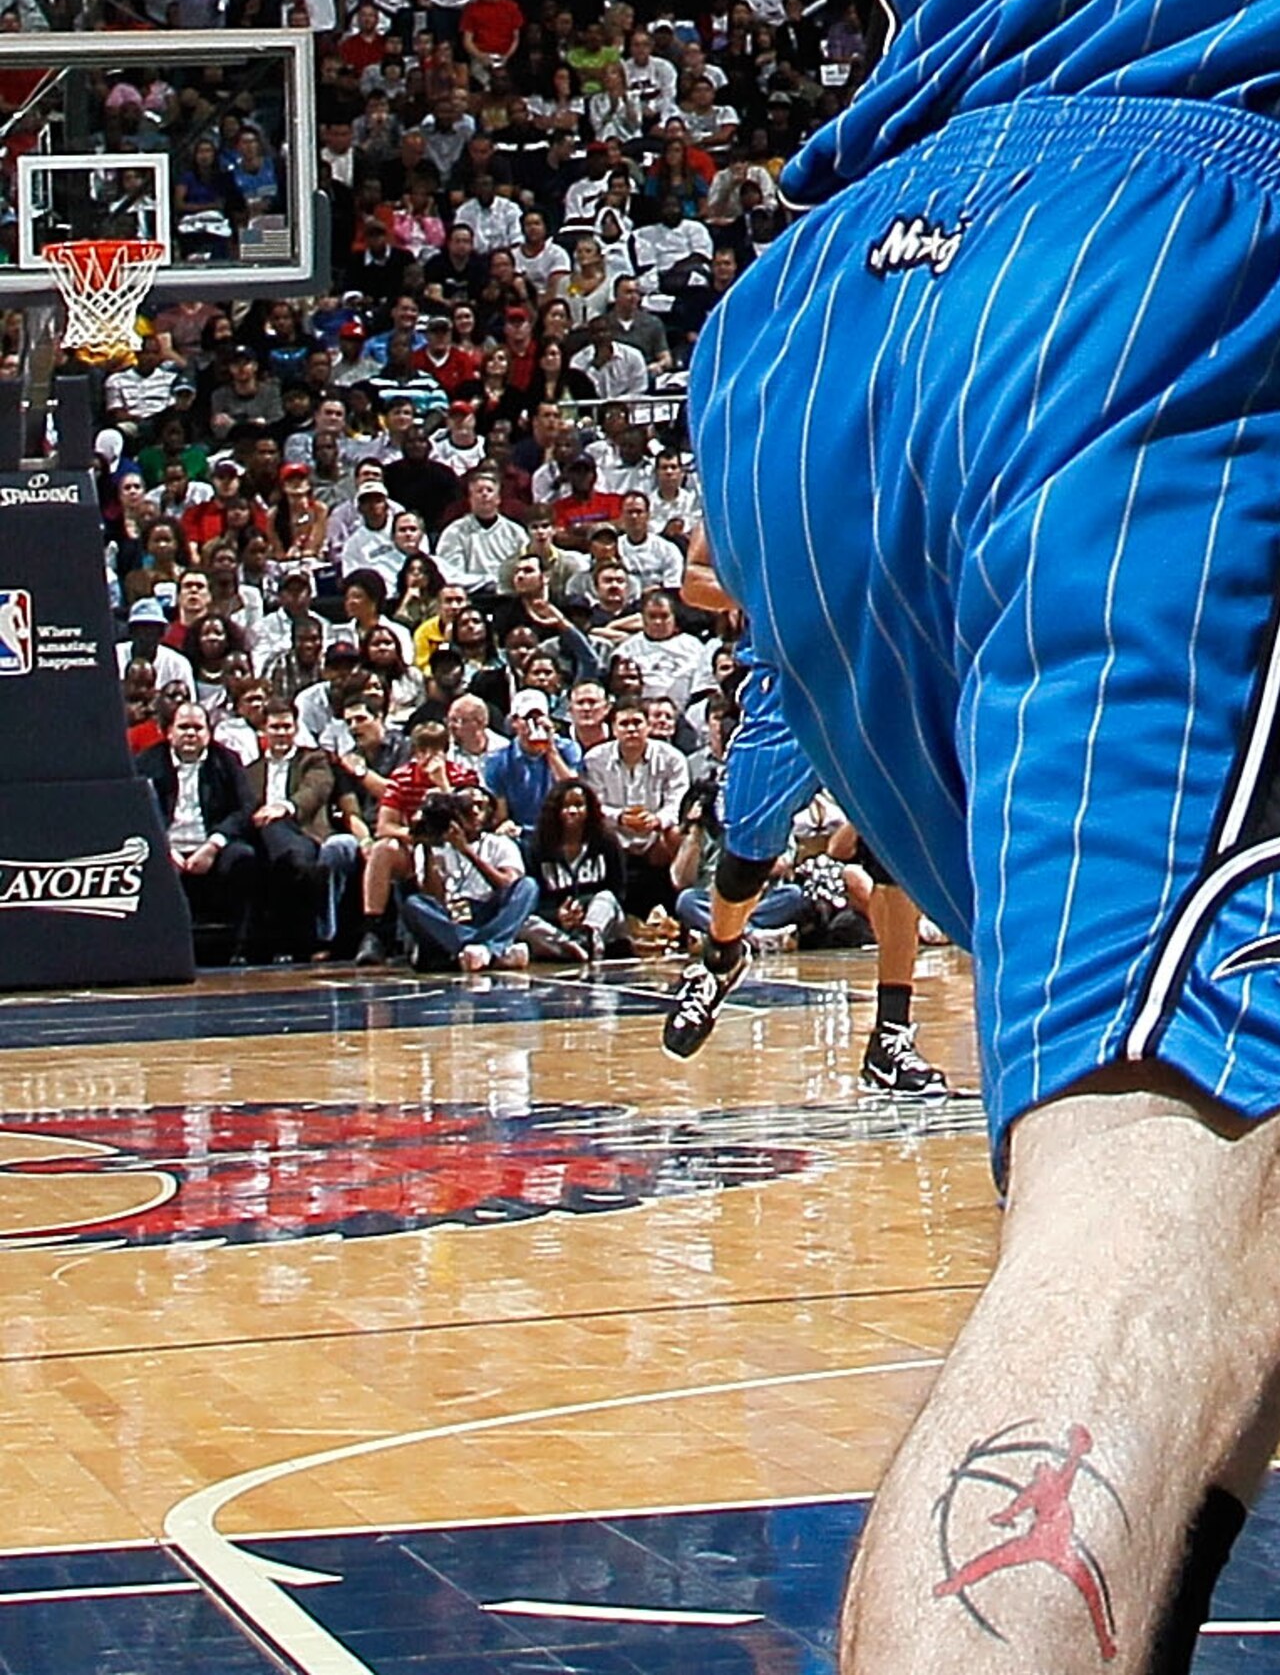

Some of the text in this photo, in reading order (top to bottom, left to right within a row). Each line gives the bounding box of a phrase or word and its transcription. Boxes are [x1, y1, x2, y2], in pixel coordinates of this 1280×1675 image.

[0, 485, 79, 506] SPALDING
[36, 625, 82, 637] Where
[37, 641, 97, 654] amazing
